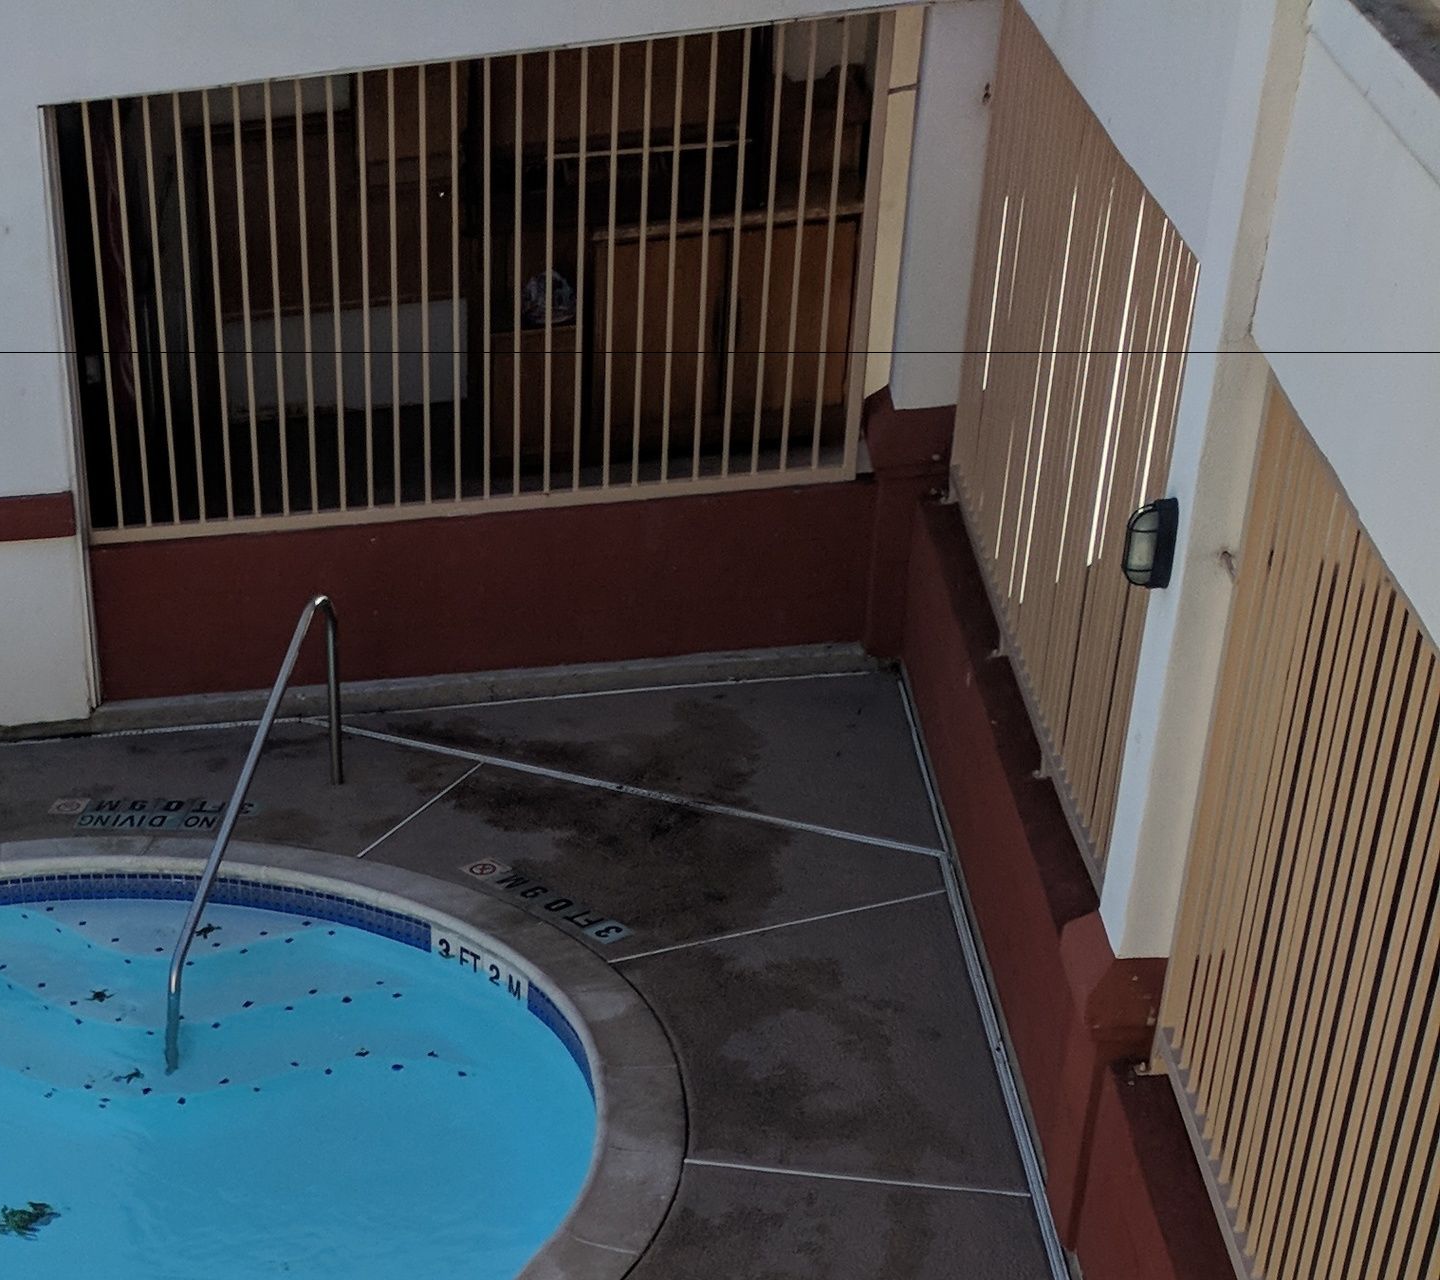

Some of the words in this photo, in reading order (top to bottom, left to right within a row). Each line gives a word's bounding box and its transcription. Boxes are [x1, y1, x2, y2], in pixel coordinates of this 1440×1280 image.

[192, 801, 225, 813] FT
[78, 815, 165, 828] DIVING
[184, 815, 217, 828] NO
[496, 873, 530, 890] M
[563, 909, 605, 928] FT
[594, 924, 624, 938] 3
[438, 938, 451, 958] 3
[460, 946, 481, 973] FT
[489, 964, 501, 987] 2
[508, 973, 522, 1000] M
